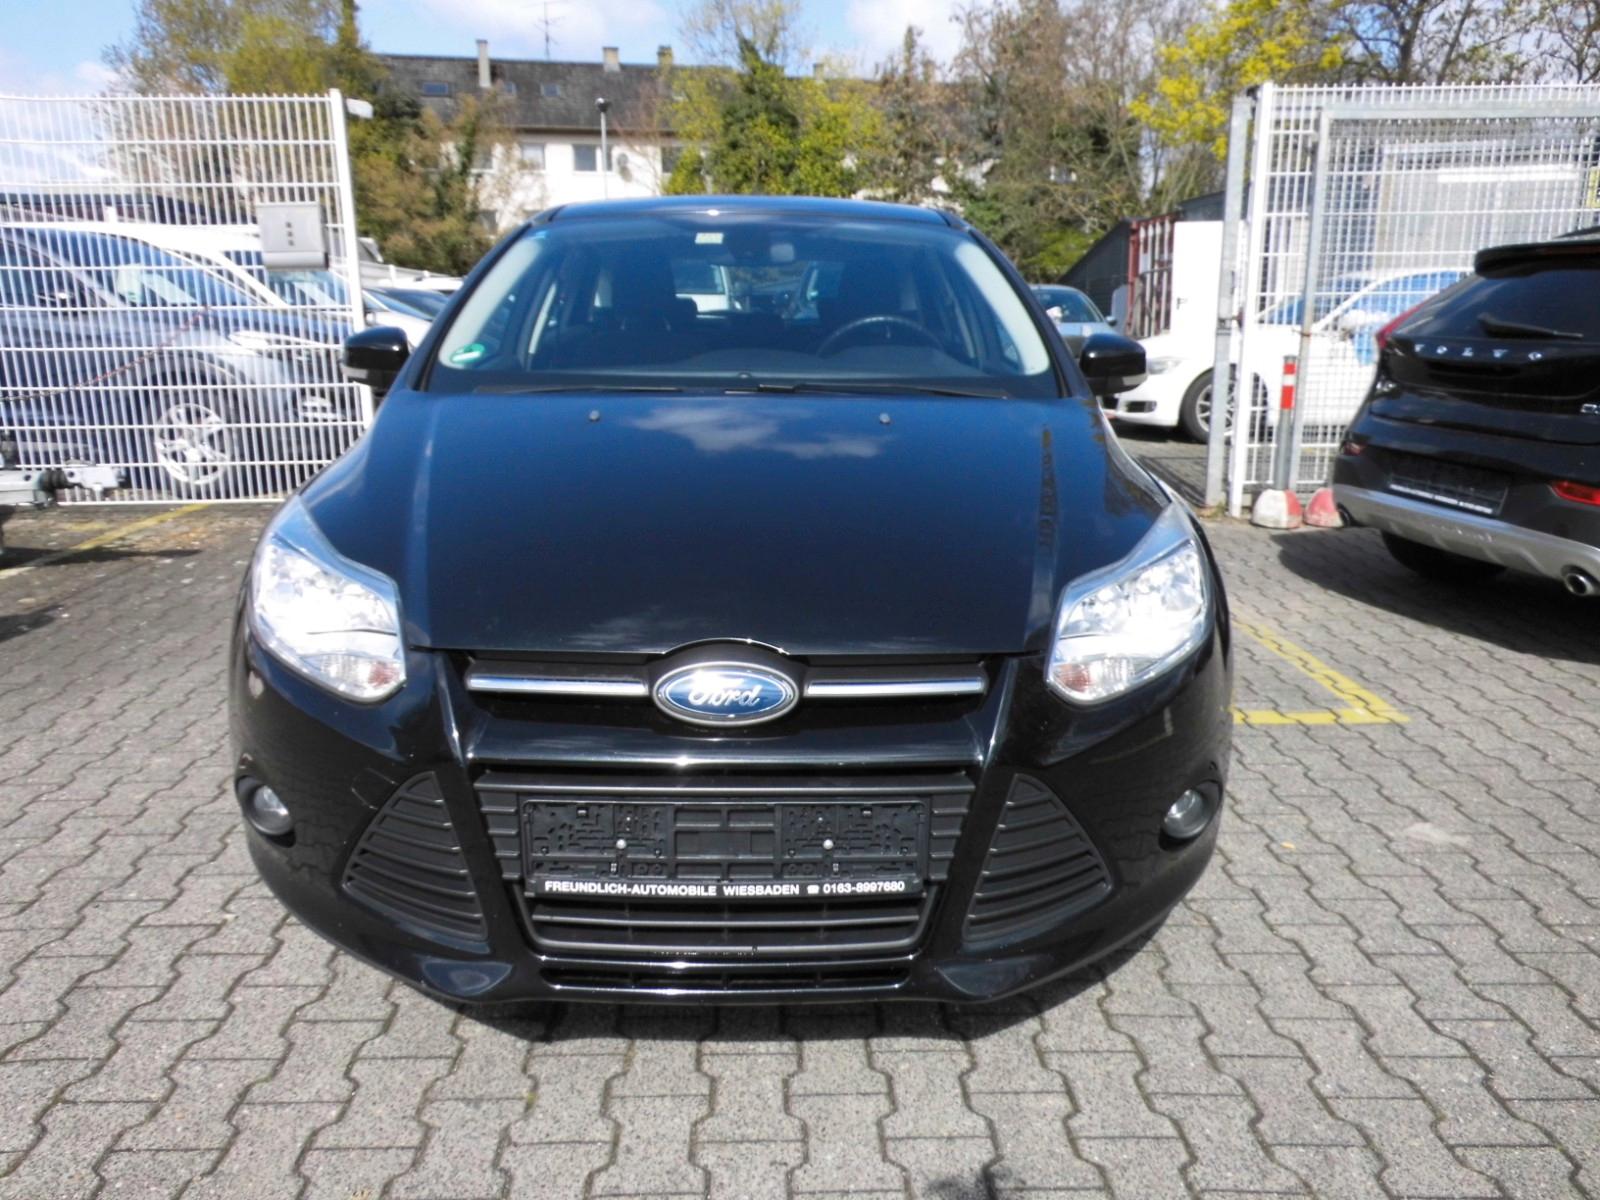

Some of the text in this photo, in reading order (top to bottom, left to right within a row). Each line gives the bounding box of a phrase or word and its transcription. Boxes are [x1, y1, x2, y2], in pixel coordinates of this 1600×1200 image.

[687, 676, 762, 706] Ford
[544, 880, 906, 896] FREUNDLICH-AUTOMOBILE WIESBADEN 0163-8997680
